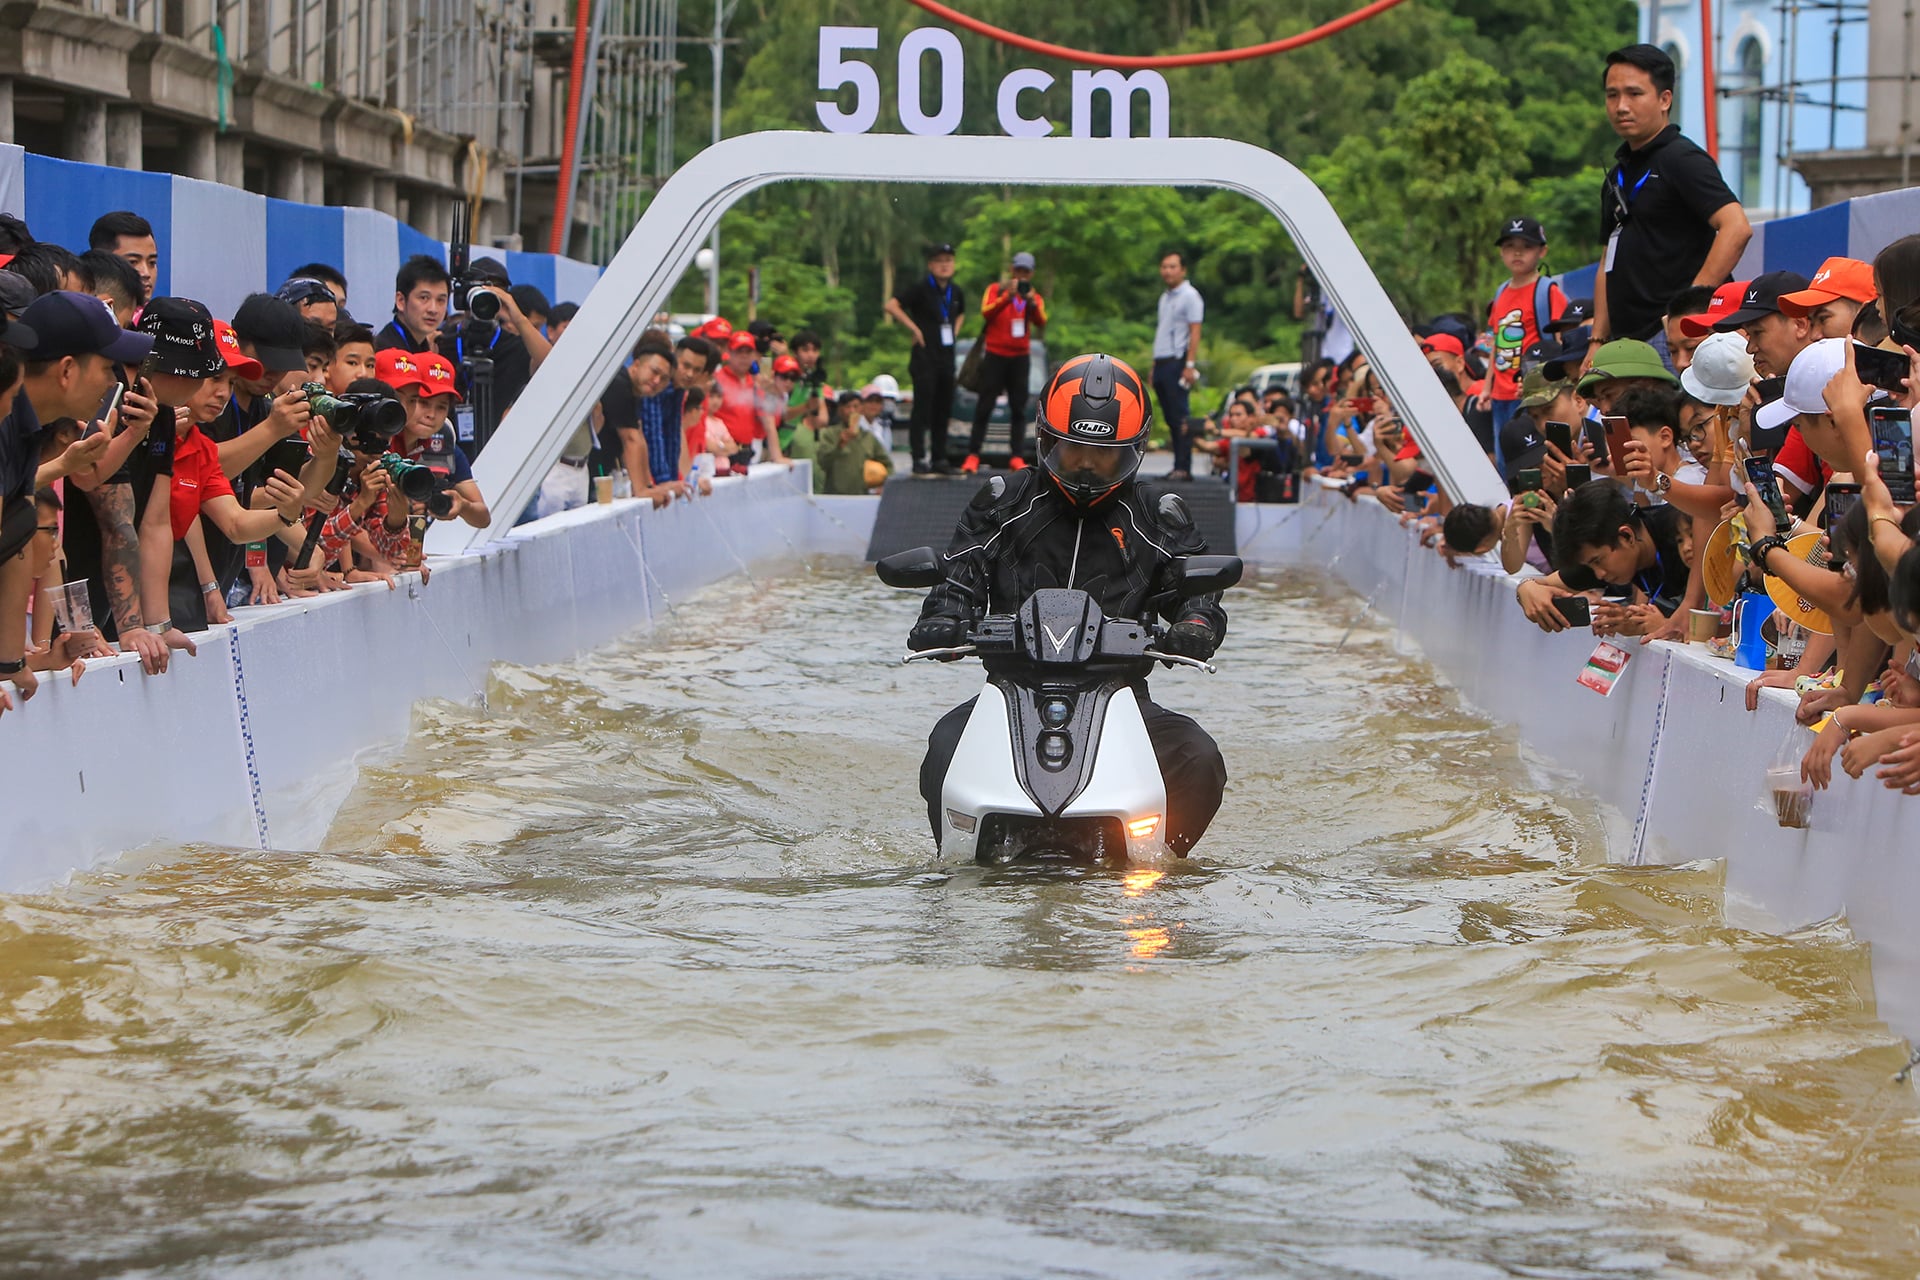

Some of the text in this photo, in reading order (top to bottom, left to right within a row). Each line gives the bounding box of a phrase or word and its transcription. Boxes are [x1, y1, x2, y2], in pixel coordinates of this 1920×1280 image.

[815, 26, 1170, 139] 50 cm
[1076, 422, 1109, 433] HJC
